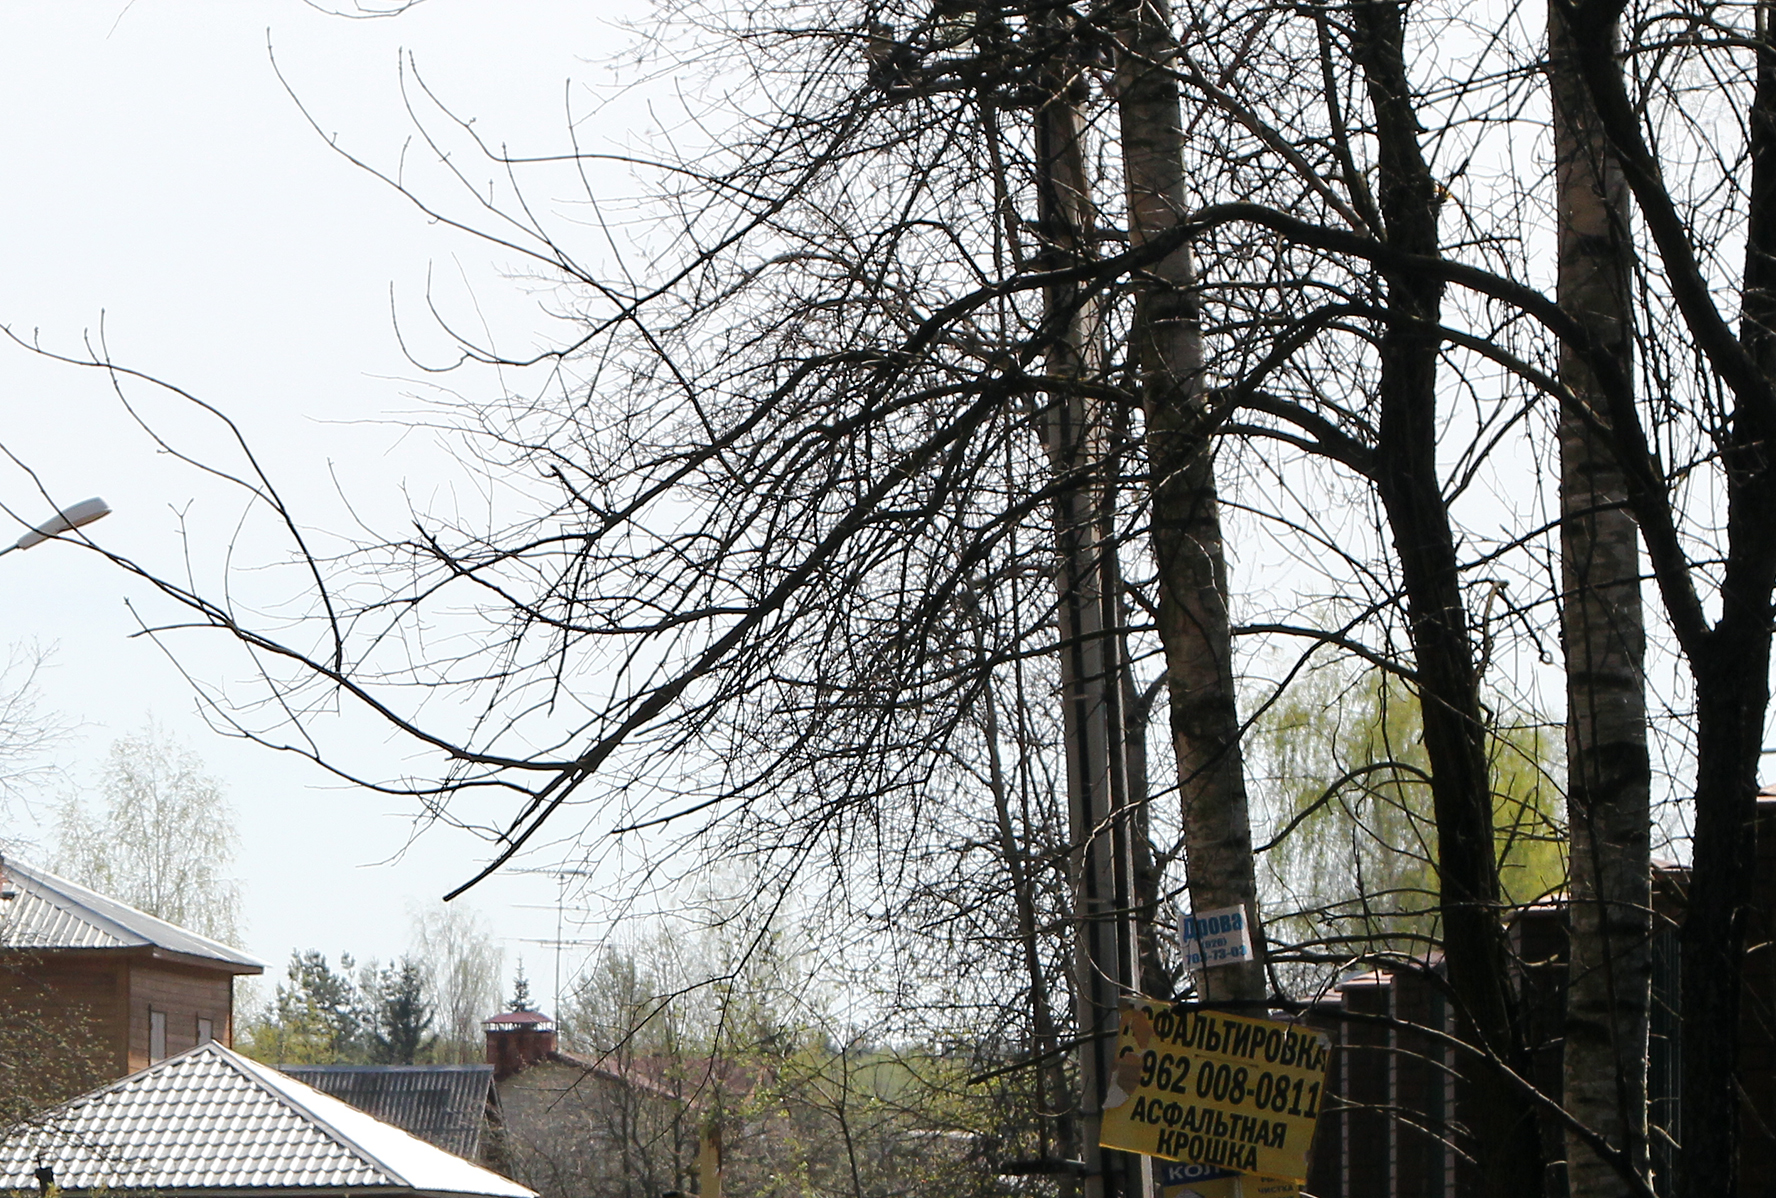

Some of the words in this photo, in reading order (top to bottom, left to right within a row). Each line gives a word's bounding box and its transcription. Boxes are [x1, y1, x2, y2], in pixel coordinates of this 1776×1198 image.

[1183, 912, 1243, 943] Дрова
[1122, 1005, 1326, 1072] ФАЛЬТИРОВКА
[1140, 1050, 1190, 1095] 962
[1196, 1060, 1321, 1119] 008-0811
[1130, 1096, 1288, 1149] АСФАЛЬТНАЯ
[1156, 1128, 1258, 1171] КРОШКА
[1258, 1184, 1294, 1195] ЧИСТКА
